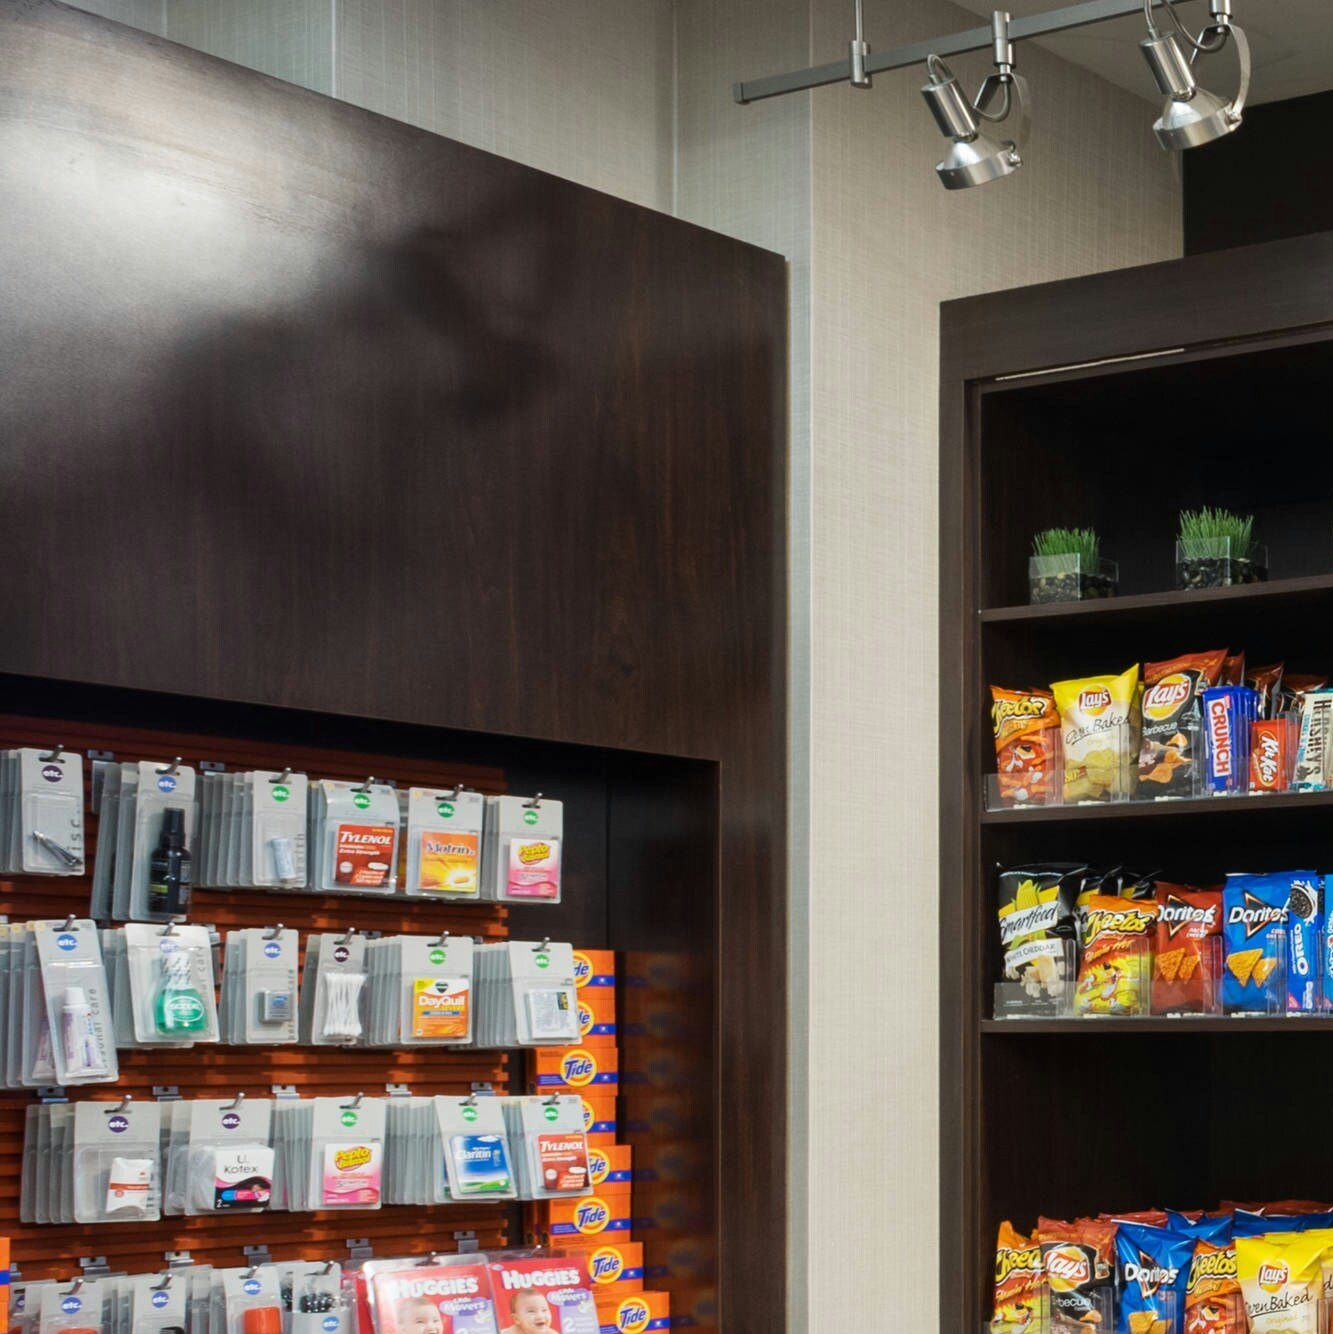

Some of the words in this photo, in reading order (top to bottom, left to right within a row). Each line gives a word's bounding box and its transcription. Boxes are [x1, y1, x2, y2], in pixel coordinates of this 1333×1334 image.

[1080, 689, 1110, 709] Lay's
[1147, 679, 1189, 708] Lay's
[1211, 701, 1231, 774] CRUNCH
[340, 831, 392, 846] TYLENOL
[1229, 905, 1289, 924] Doritos
[1294, 923, 1309, 976] OREO
[418, 994, 464, 1009] DayQuil
[564, 1058, 593, 1077] Tide
[539, 1140, 585, 1153] TYLENOL
[577, 1207, 606, 1227] Tide
[592, 1256, 620, 1276] Tide
[1046, 1253, 1088, 1277] Lay's
[1124, 1262, 1179, 1283] Doritos
[1260, 1264, 1288, 1284] Lay's
[392, 1276, 479, 1298] HUGGIES
[501, 1269, 580, 1290] HUGGIES
[1271, 1288, 1311, 1312] Baked
[619, 1307, 647, 1326] Tide
